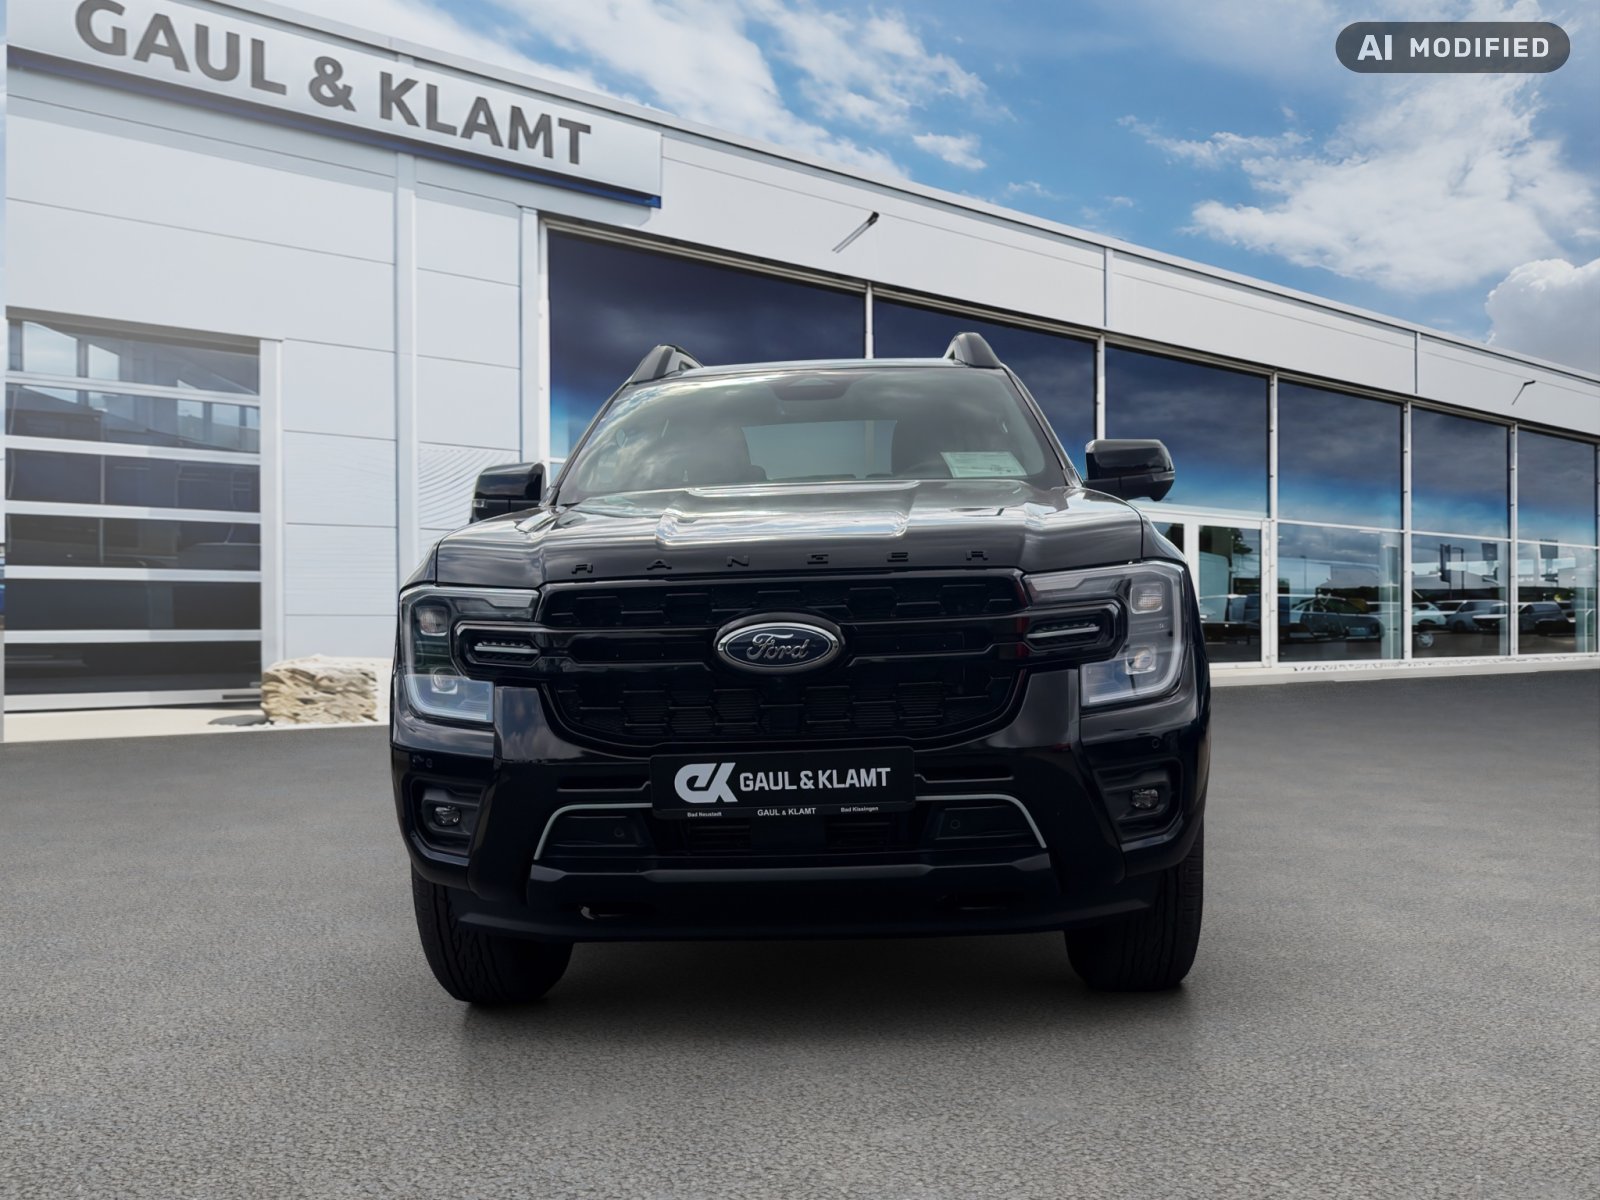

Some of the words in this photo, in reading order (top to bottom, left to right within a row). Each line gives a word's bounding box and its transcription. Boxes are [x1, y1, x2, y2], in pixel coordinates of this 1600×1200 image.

[75, 0, 287, 96] GAUL
[308, 56, 357, 112] &
[379, 71, 592, 165] KLAMT
[746, 633, 811, 660] Ford
[739, 771, 798, 791] GAUL
[800, 770, 815, 789] &
[818, 767, 891, 788] KLAMT
[757, 808, 780, 817] GAUL
[788, 807, 817, 816] KLAMT
